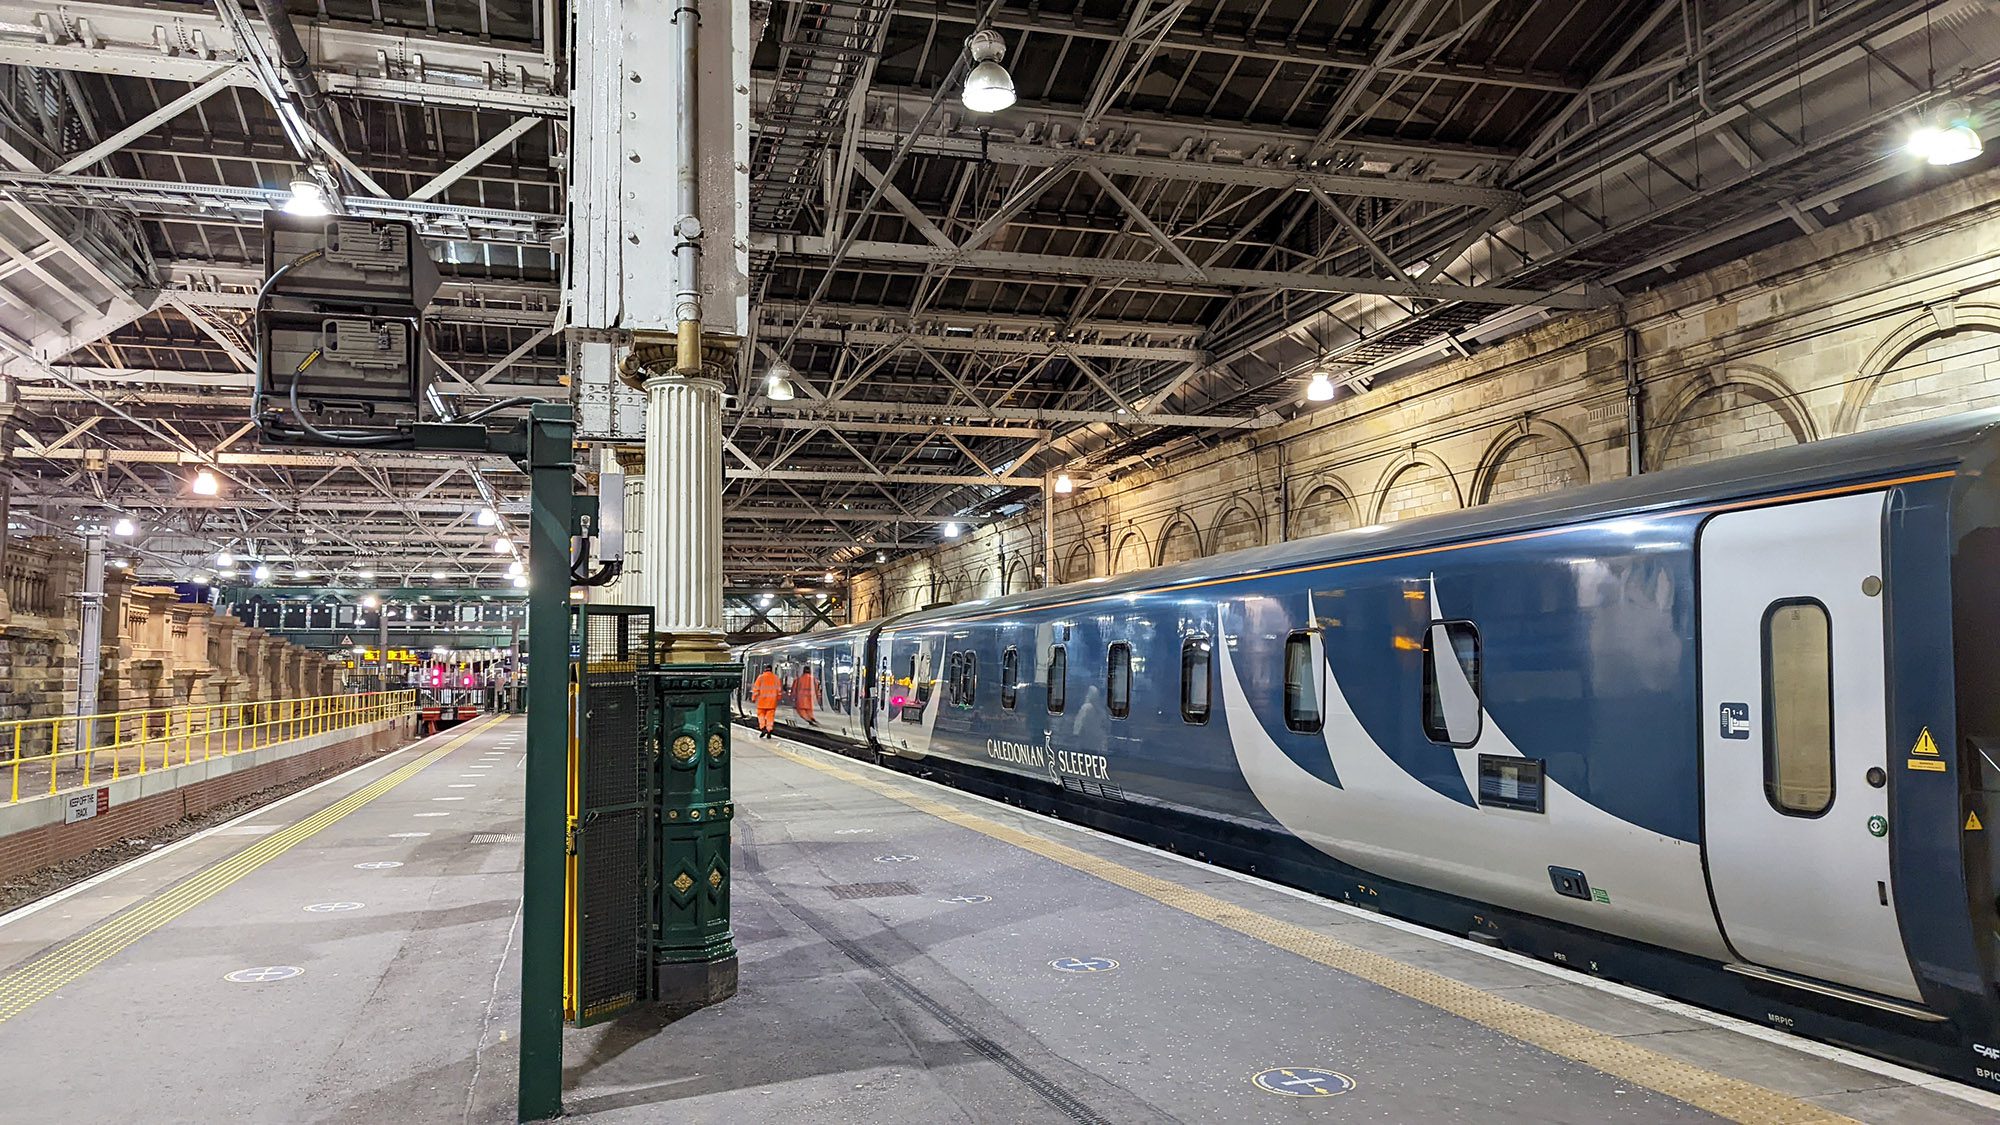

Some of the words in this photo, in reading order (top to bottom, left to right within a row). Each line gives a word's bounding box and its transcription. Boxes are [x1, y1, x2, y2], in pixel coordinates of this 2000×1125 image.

[987, 739, 1045, 767] CALEDONIAN
[1058, 750, 1111, 781] SLEEPER
[1767, 1012, 1794, 1027] MRPIC
